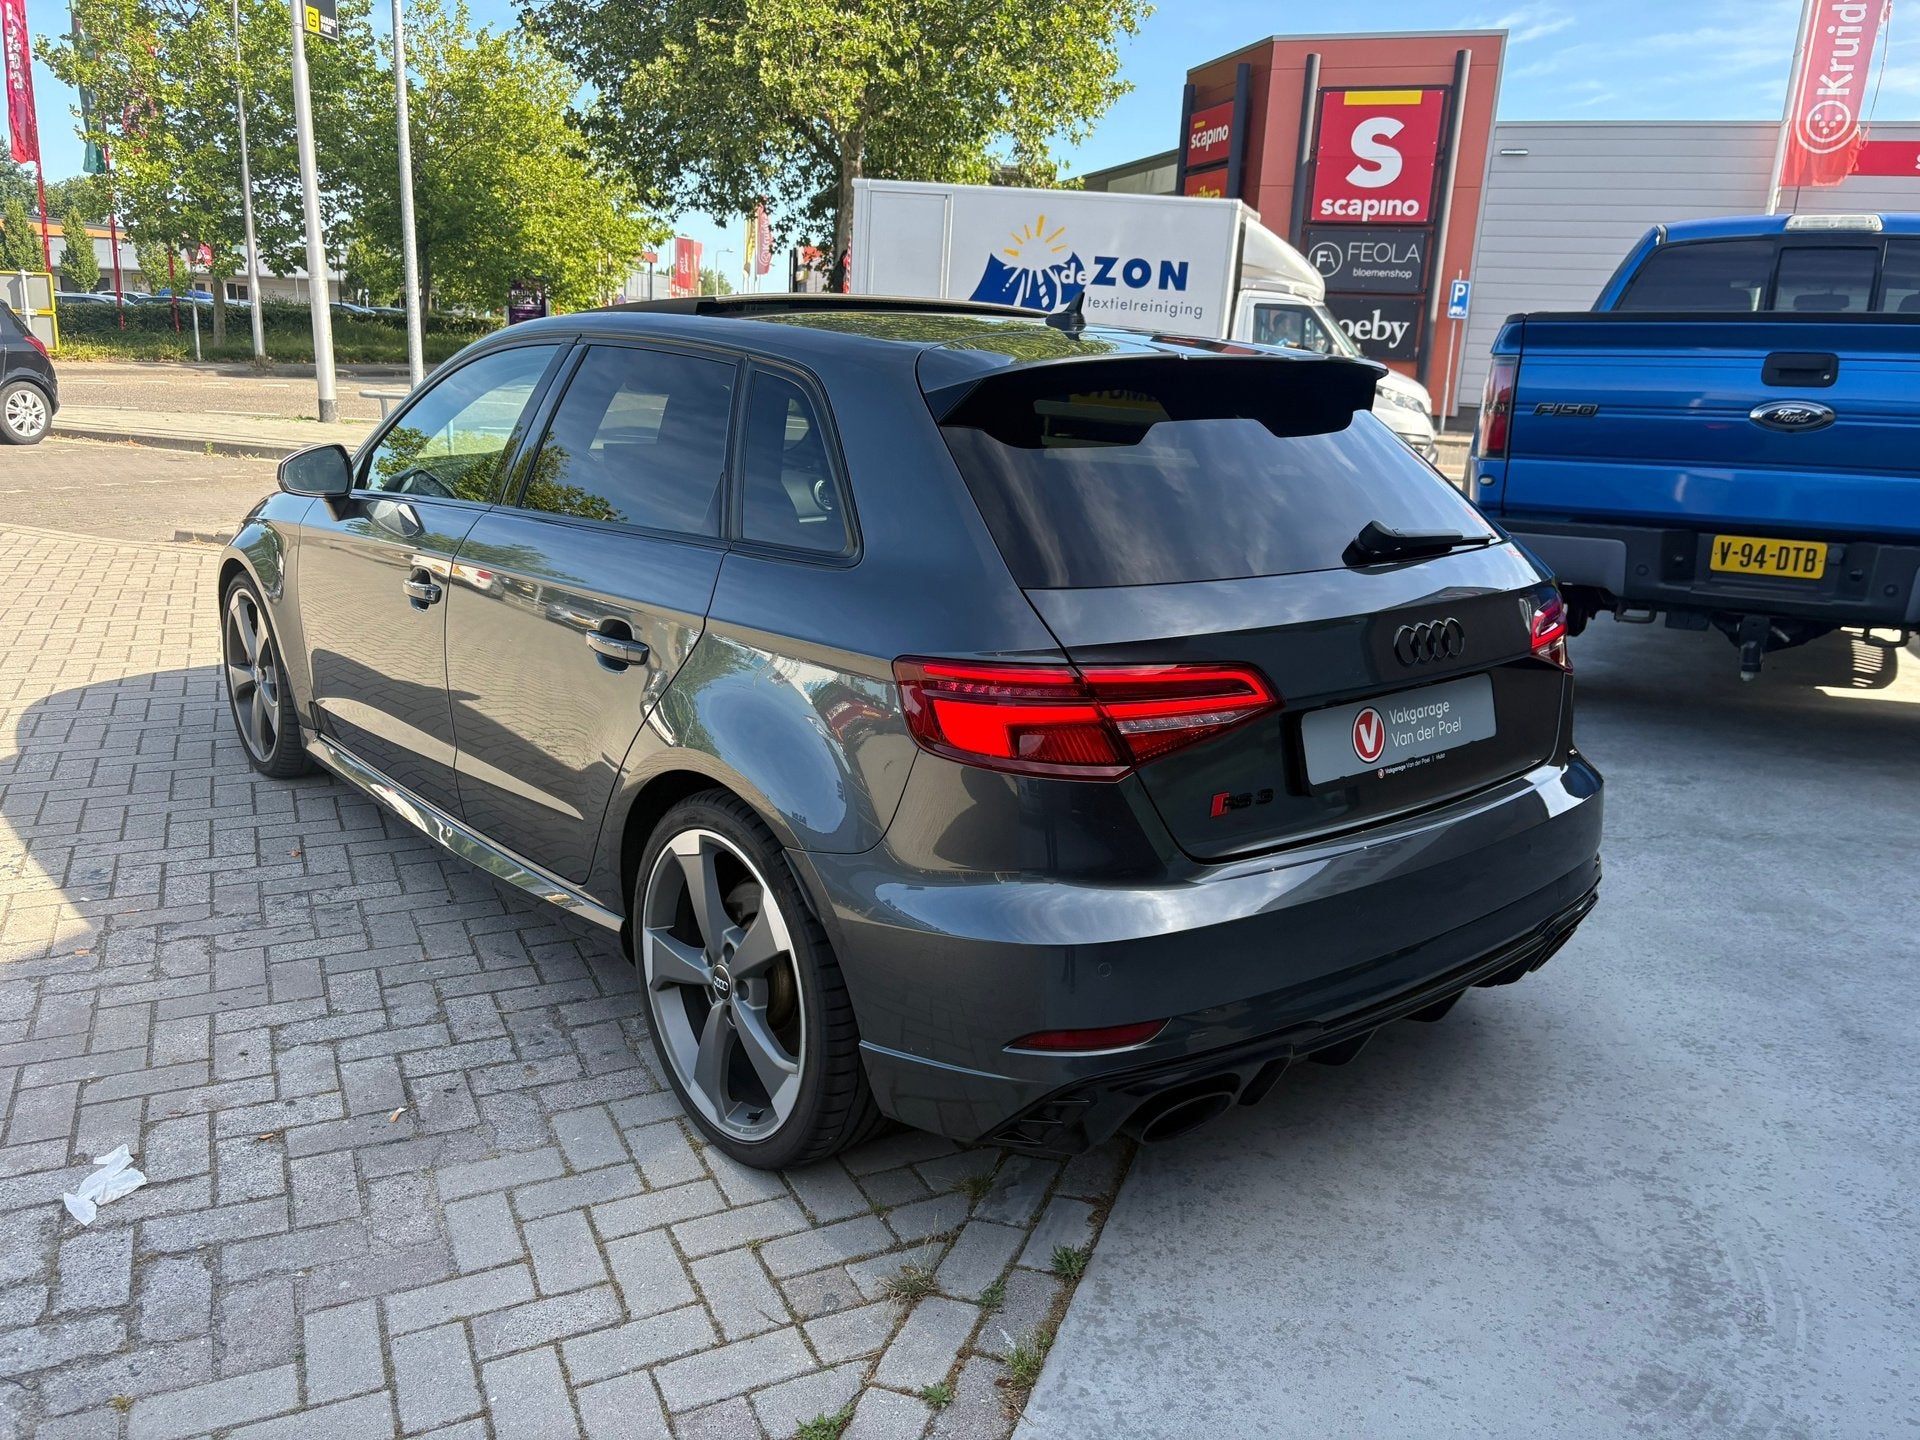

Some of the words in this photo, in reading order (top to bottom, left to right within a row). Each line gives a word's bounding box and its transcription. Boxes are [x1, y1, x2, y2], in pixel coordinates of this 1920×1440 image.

[1815, 0, 1868, 96] Kruid
[1190, 124, 1229, 152] scapino
[1345, 117, 1405, 188] S
[1320, 199, 1419, 222] scapino
[1347, 242, 1421, 264] FEOLA
[1060, 262, 1087, 286] de
[1090, 256, 1189, 291] ZON
[1352, 267, 1413, 280] bloemenshop
[1453, 283, 1466, 303] P
[1087, 296, 1203, 319] textielreiniging
[1774, 408, 1811, 423] Ford
[1720, 541, 1817, 573] V-94-DTB
[1389, 701, 1450, 725] Vakgarage
[1358, 711, 1380, 753] V
[1391, 731, 1415, 748] Van
[1416, 726, 1436, 742] der
[1438, 716, 1462, 736] Poel
[1209, 791, 1253, 818] RS
[1255, 788, 1274, 805] 3
